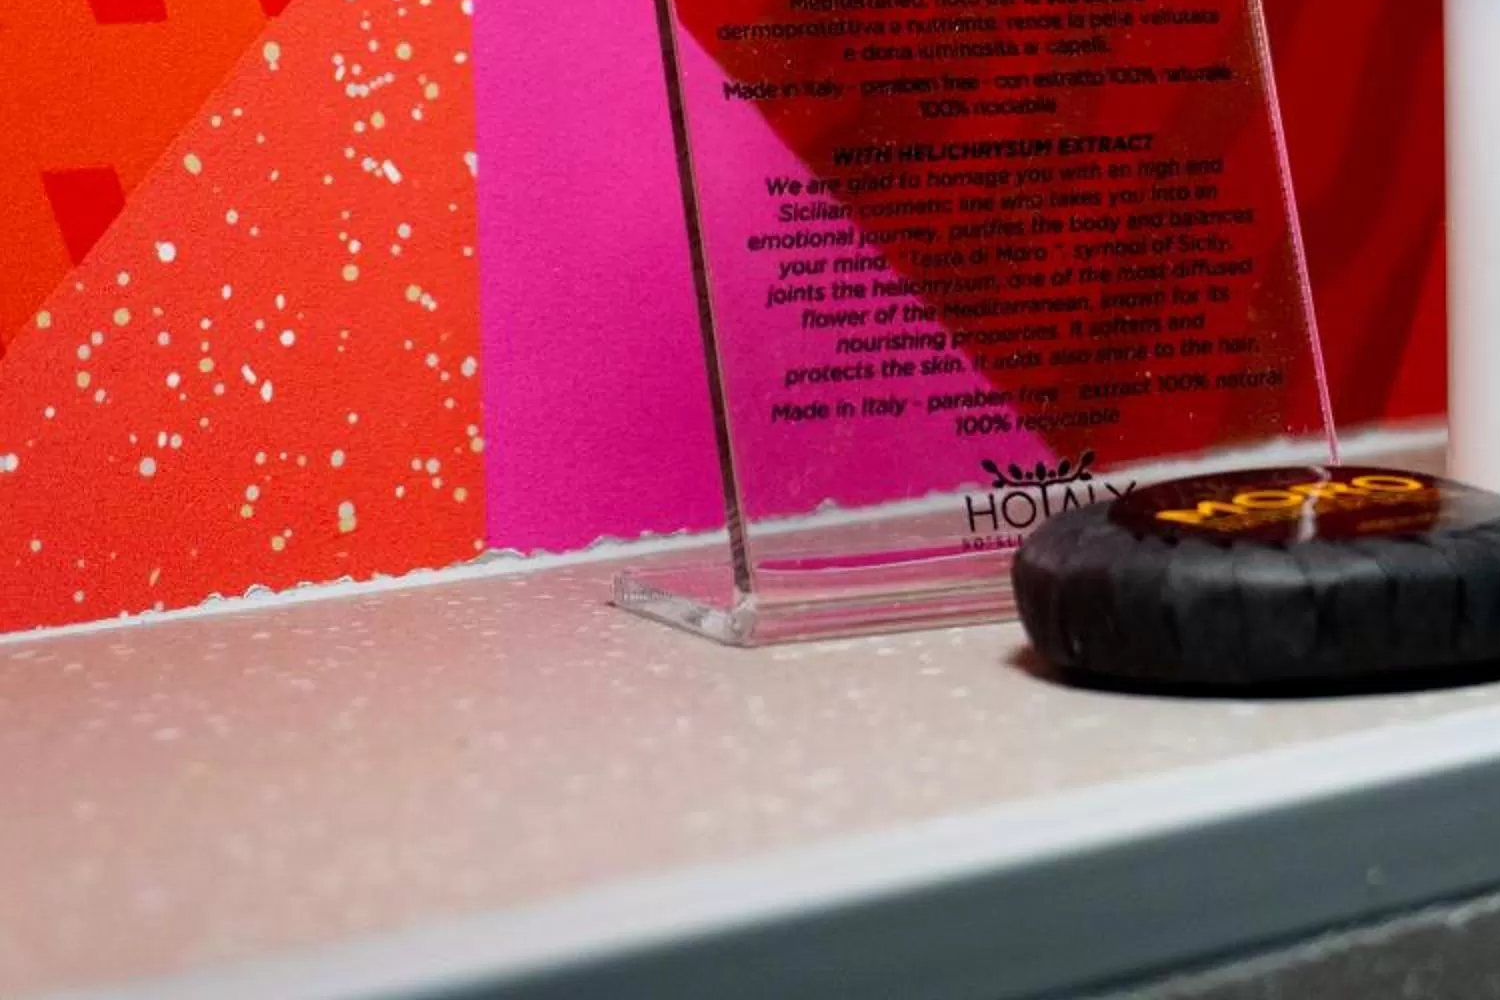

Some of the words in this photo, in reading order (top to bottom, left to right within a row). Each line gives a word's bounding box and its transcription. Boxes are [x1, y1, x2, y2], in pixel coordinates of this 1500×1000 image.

[723, 81, 777, 100] Made
[783, 81, 799, 98] in
[802, 79, 842, 100] Italy
[920, 99, 971, 119] 100%
[833, 144, 891, 168] WITH
[900, 138, 1052, 164] HELICHRYSUM
[1057, 134, 1153, 155] EXTRACT
[766, 176, 803, 196] We
[806, 177, 841, 194] are
[847, 171, 893, 194] glad
[928, 166, 1009, 188] homage
[1016, 168, 1050, 186] you
[1060, 163, 1100, 182] with
[747, 227, 854, 251] emotional
[1031, 214, 1063, 233] the
[1069, 212, 1121, 233] body
[1127, 209, 1163, 229] and
[778, 201, 851, 223] Sicilian
[779, 257, 827, 281] your
[1152, 234, 1176, 252] of
[766, 283, 826, 309] joints
[831, 280, 868, 299] the
[1007, 271, 1044, 289] one
[1050, 267, 1074, 286] of
[800, 307, 870, 330] flower
[874, 304, 898, 325] of
[901, 302, 938, 322] the
[834, 329, 947, 355] nourishing
[1167, 312, 1206, 332] and
[783, 360, 876, 388] protects
[881, 357, 915, 378] the
[919, 354, 967, 375] skin.
[1180, 337, 1213, 355] the
[770, 400, 831, 423] Made
[836, 398, 856, 418] in
[860, 395, 907, 418] Italy
[926, 388, 1013, 413] paraben
[1078, 377, 1152, 399] extract
[1157, 372, 1209, 393] 100%
[1214, 367, 1284, 389] natural
[955, 413, 1012, 436] 100%
[1155, 475, 1423, 524] MORO
